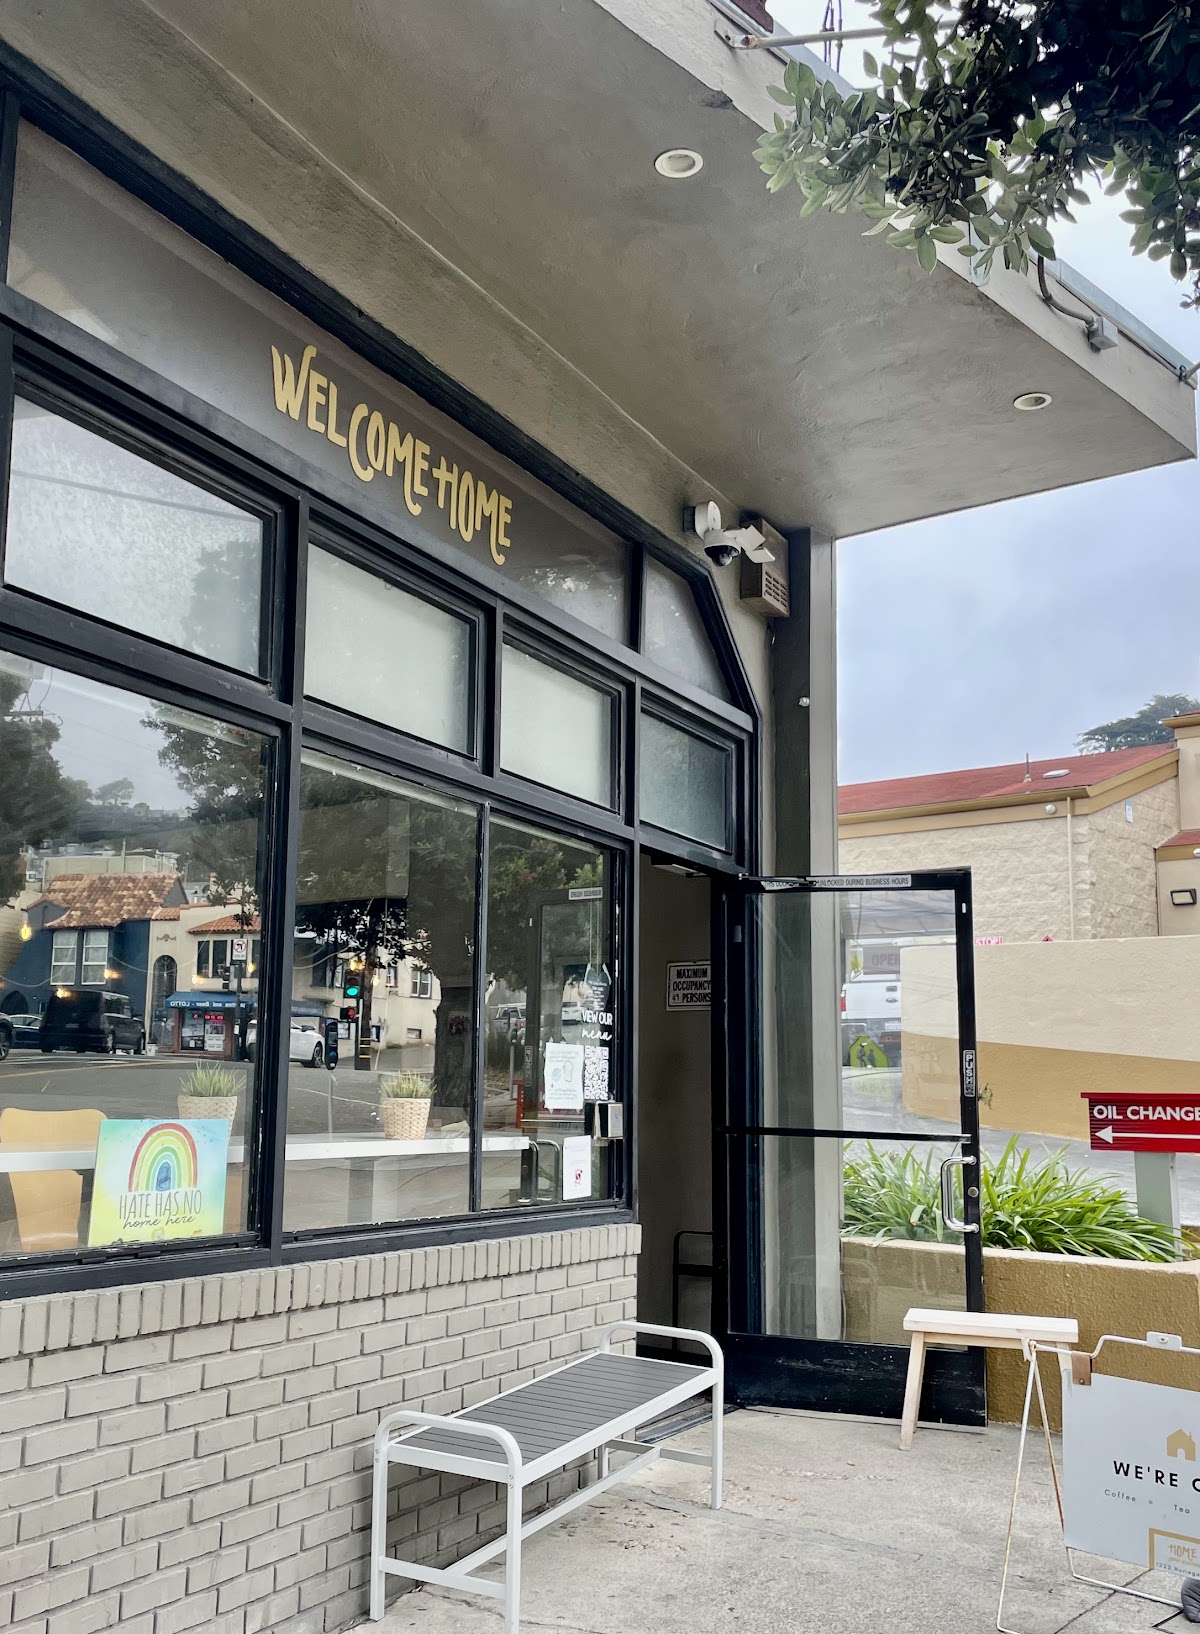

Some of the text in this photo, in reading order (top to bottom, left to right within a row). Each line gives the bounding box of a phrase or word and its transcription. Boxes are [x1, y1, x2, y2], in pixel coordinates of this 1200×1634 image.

[271, 345, 513, 565] WELCOME HOME
[892, 877, 909, 885] HOURS
[677, 967, 708, 979] MAXIMUM
[673, 980, 712, 991] OCCUPANCY
[682, 992, 711, 1003] PERSONS
[582, 1010, 613, 1025] VIEW OUR
[582, 1028, 613, 1041] menu
[965, 1054, 974, 1085] PUSH
[1093, 1105, 1124, 1120] OIL
[120, 1190, 202, 1219] HATE HAS NO
[122, 1211, 195, 1230] home here
[1113, 1460, 1179, 1488] WE'RE
[1104, 1489, 1190, 1514] Coffee Tea
[1168, 1544, 1197, 1561] HOME
